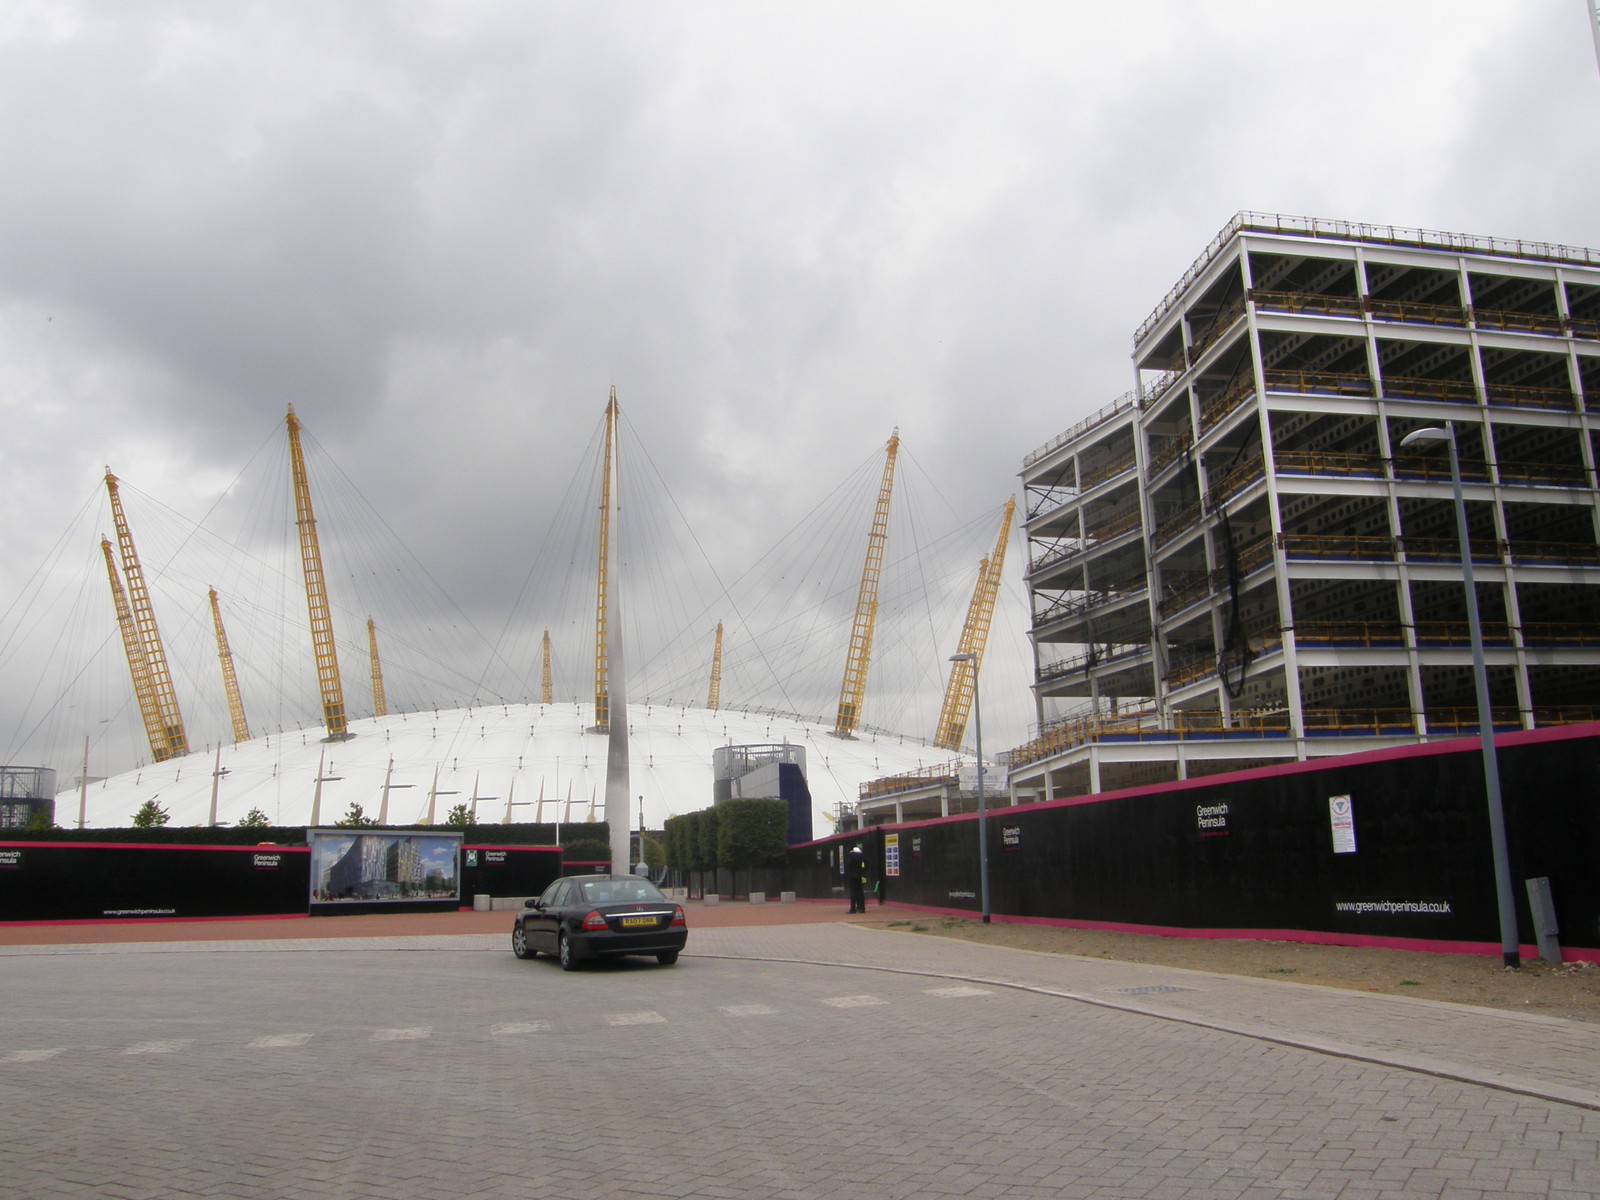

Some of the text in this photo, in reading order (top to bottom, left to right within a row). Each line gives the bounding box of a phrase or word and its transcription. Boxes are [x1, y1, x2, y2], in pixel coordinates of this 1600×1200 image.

[1196, 803, 1229, 817] Greenwich
[1197, 815, 1226, 828] Peninsula
[1336, 900, 1451, 914] www.greenwichpeninsula.co.uk
